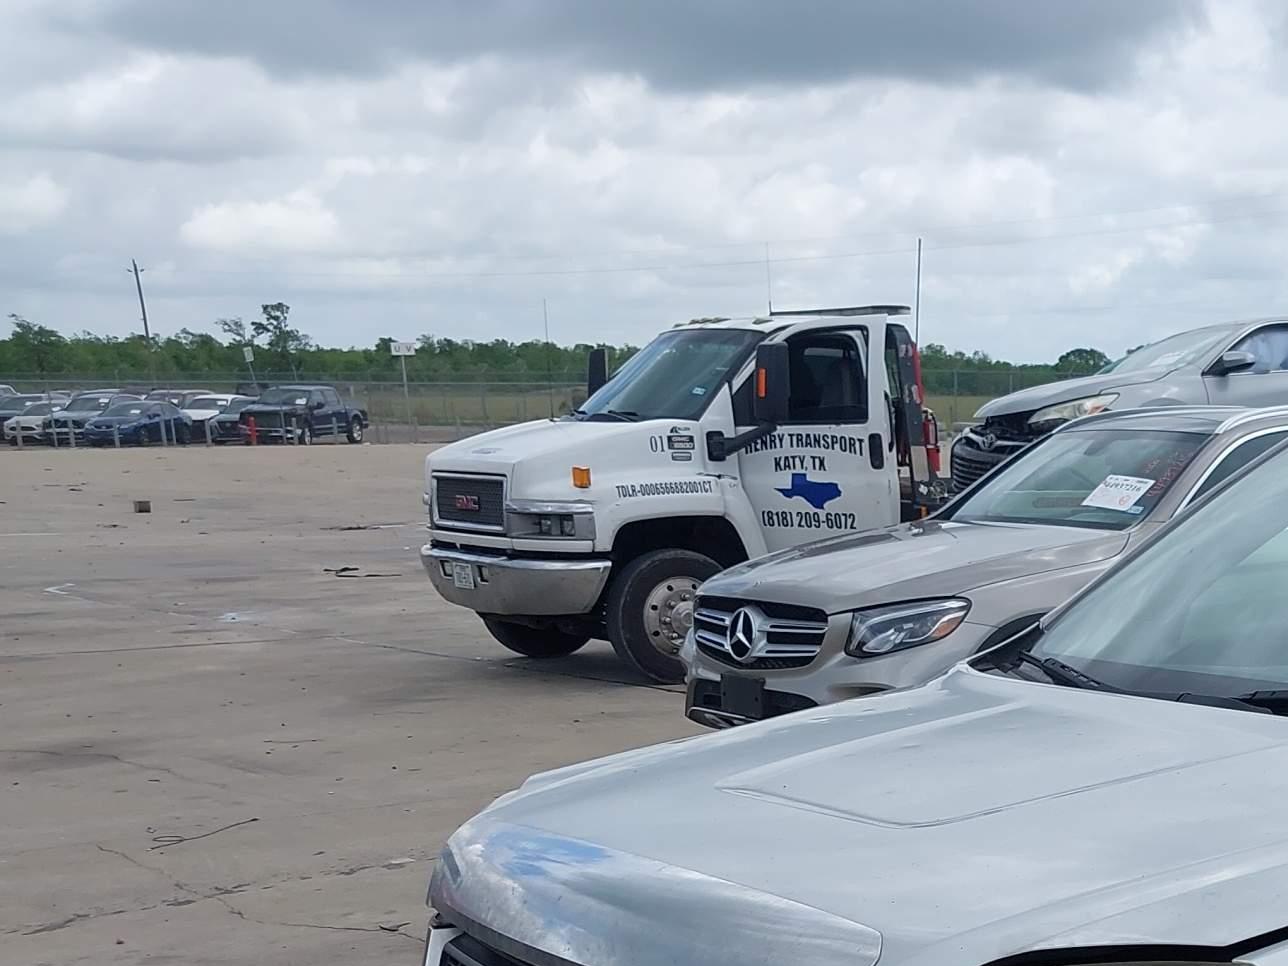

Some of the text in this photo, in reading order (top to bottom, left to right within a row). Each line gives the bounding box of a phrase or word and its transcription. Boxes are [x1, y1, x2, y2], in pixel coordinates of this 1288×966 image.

[650, 435, 665, 453] 01
[788, 433, 864, 456] TRANSPORT
[774, 456, 827, 472] KATY, TX
[761, 510, 857, 530] (818) 209-6072
